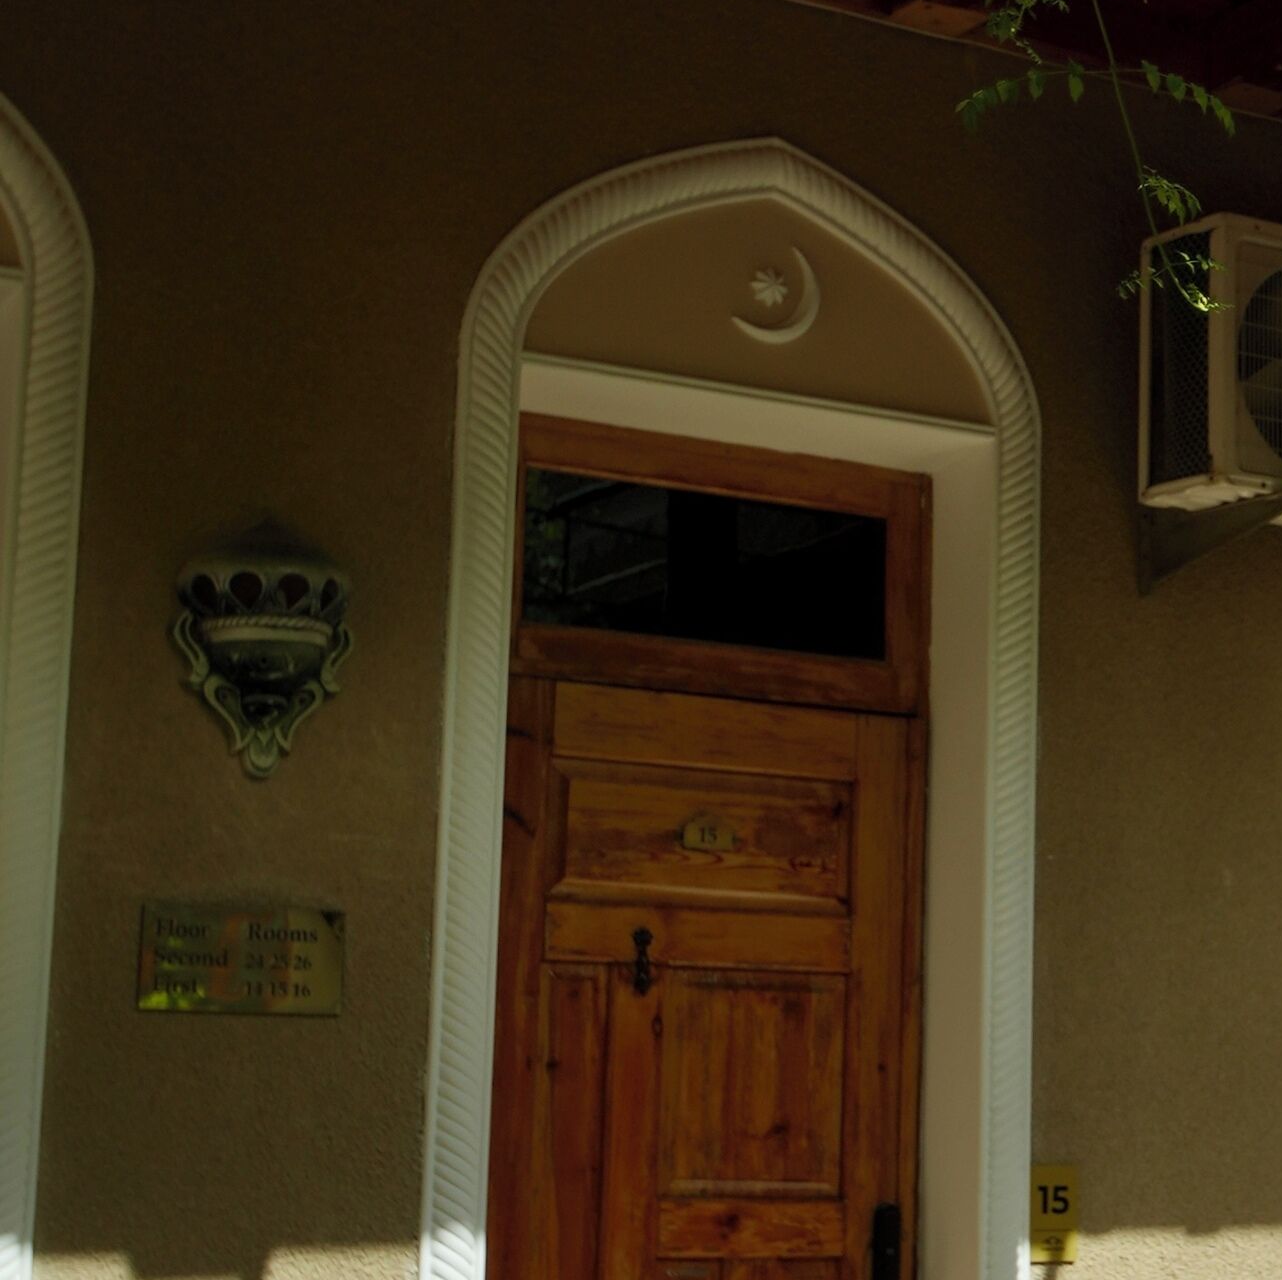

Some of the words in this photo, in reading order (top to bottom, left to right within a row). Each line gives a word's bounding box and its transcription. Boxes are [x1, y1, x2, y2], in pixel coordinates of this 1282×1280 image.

[156, 917, 210, 939] Floor
[248, 923, 319, 942] Rooms
[153, 949, 229, 967] Second
[1038, 1185, 1069, 1214] 15
